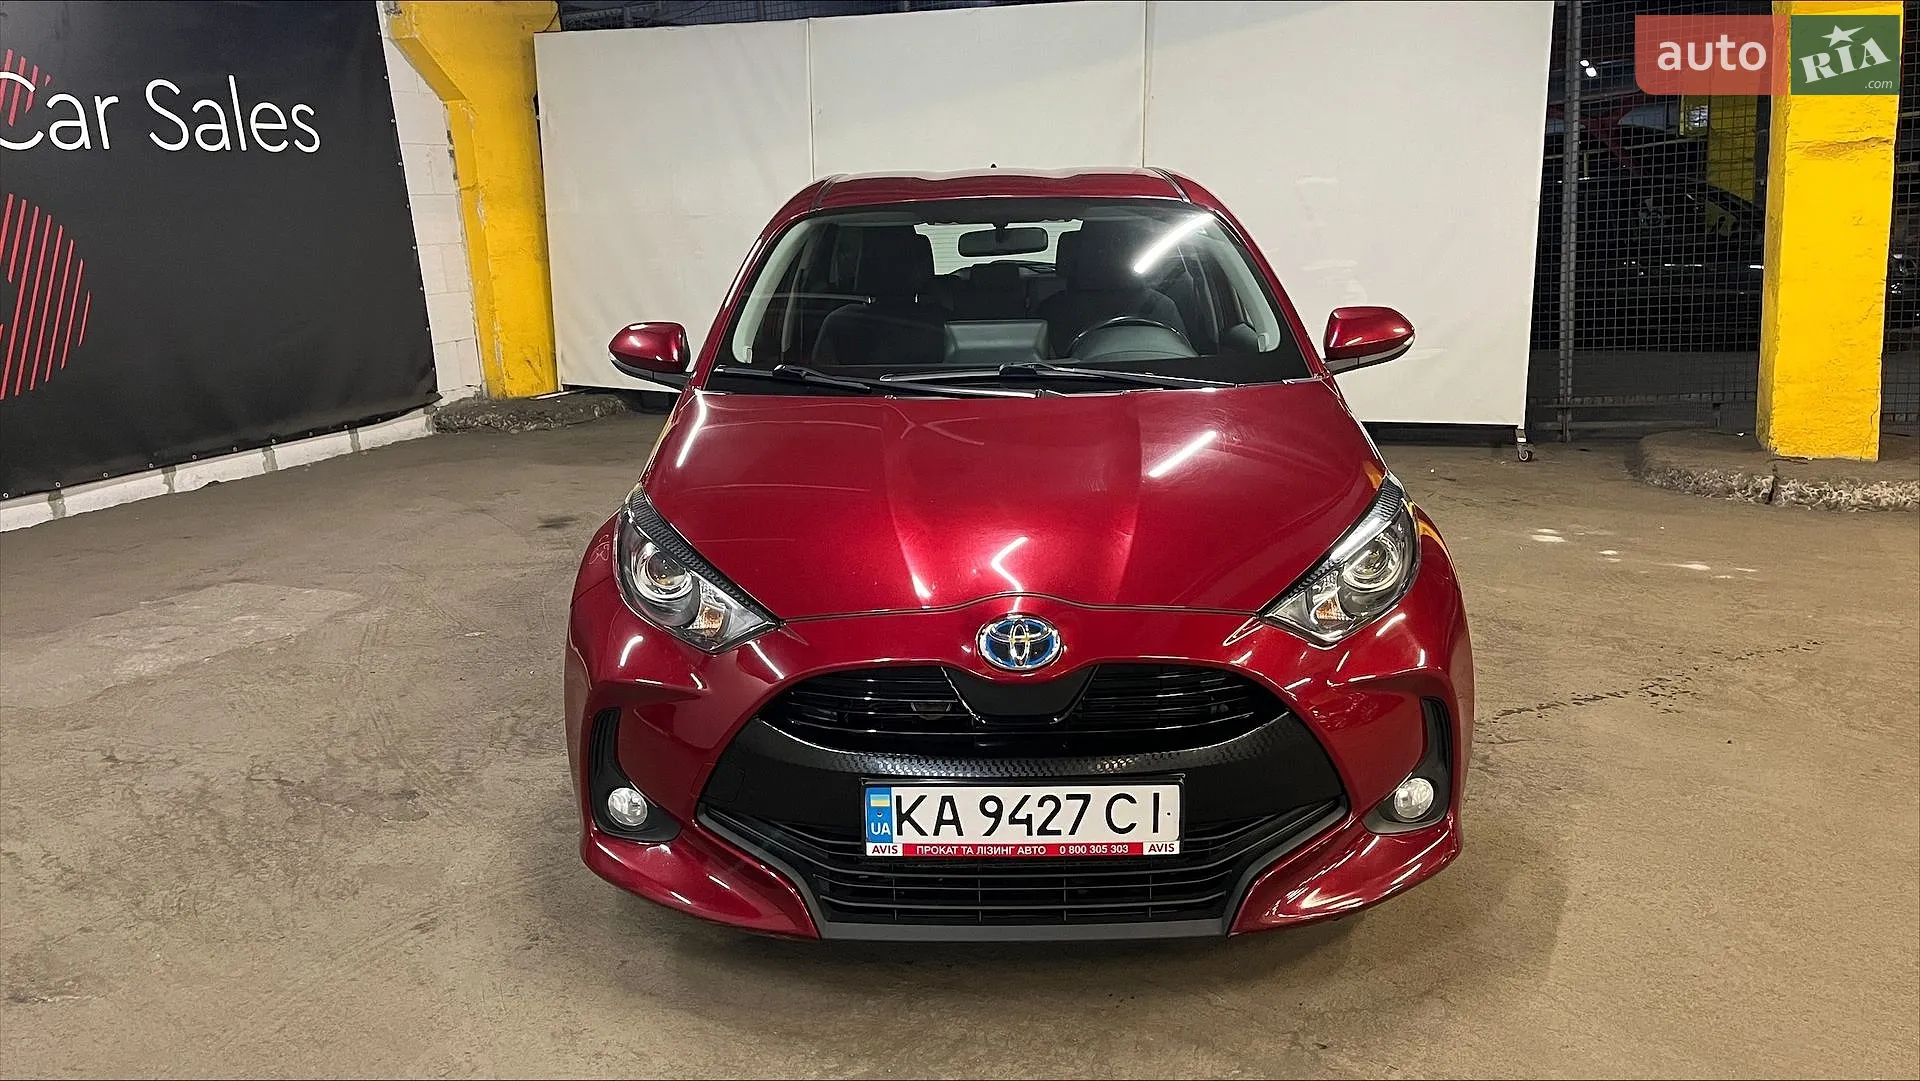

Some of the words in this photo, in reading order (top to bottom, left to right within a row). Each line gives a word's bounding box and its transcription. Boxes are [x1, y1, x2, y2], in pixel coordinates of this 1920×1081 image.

[144, 74, 321, 154] Sales
[895, 794, 964, 837] KA
[979, 793, 1091, 837] 9427
[1105, 792, 1160, 835] CI
[870, 822, 891, 836] UA
[871, 845, 899, 855] AVIS
[916, 845, 960, 856] ПРОКАТ
[960, 845, 974, 856] ТА
[976, 845, 1015, 856] ЛІЗИНГ
[1016, 845, 1047, 856] АВТО
[1059, 845, 1067, 855] 0
[1068, 845, 1088, 855] 800
[1089, 845, 1109, 855] 305
[1110, 844, 1129, 854] 303
[1147, 843, 1175, 853] AVIS
